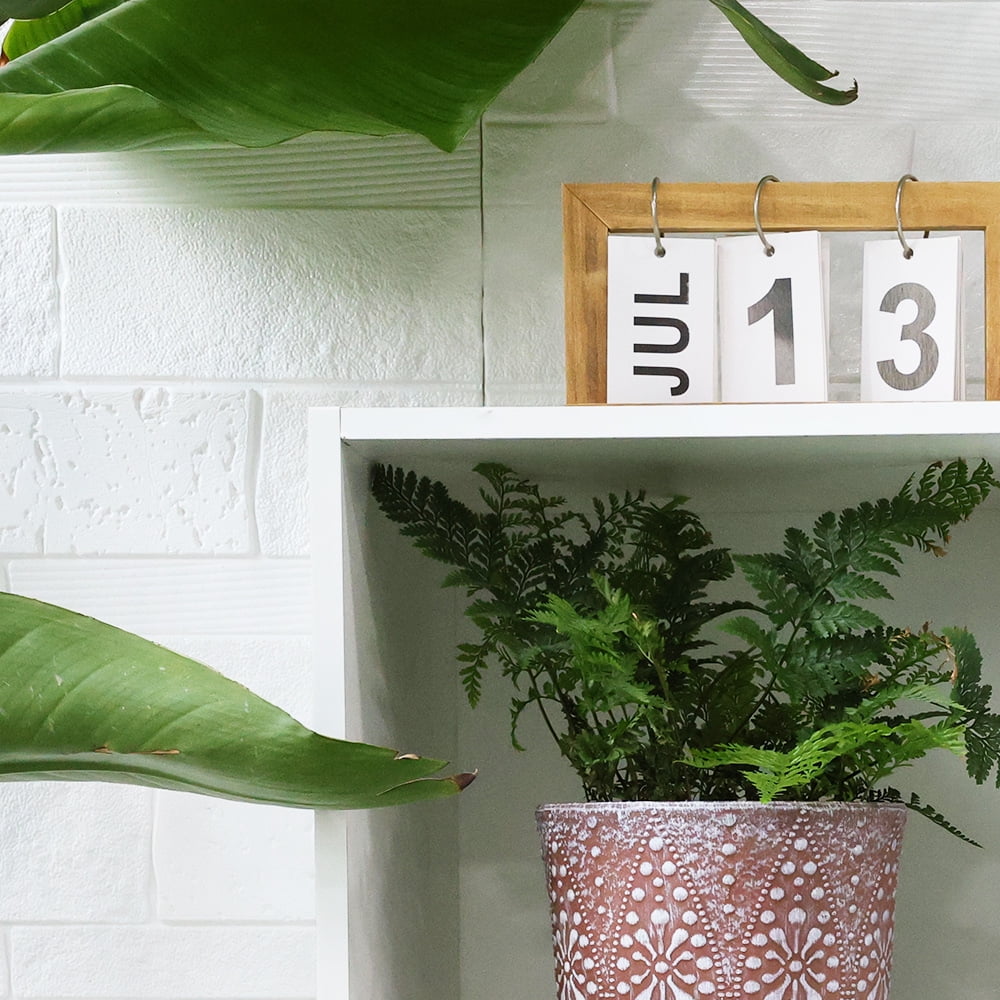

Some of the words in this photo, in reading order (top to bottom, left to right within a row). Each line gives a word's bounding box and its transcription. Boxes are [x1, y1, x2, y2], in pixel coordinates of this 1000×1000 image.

[633, 272, 690, 397] JUL
[747, 277, 796, 386] 1
[876, 282, 939, 392] 3
